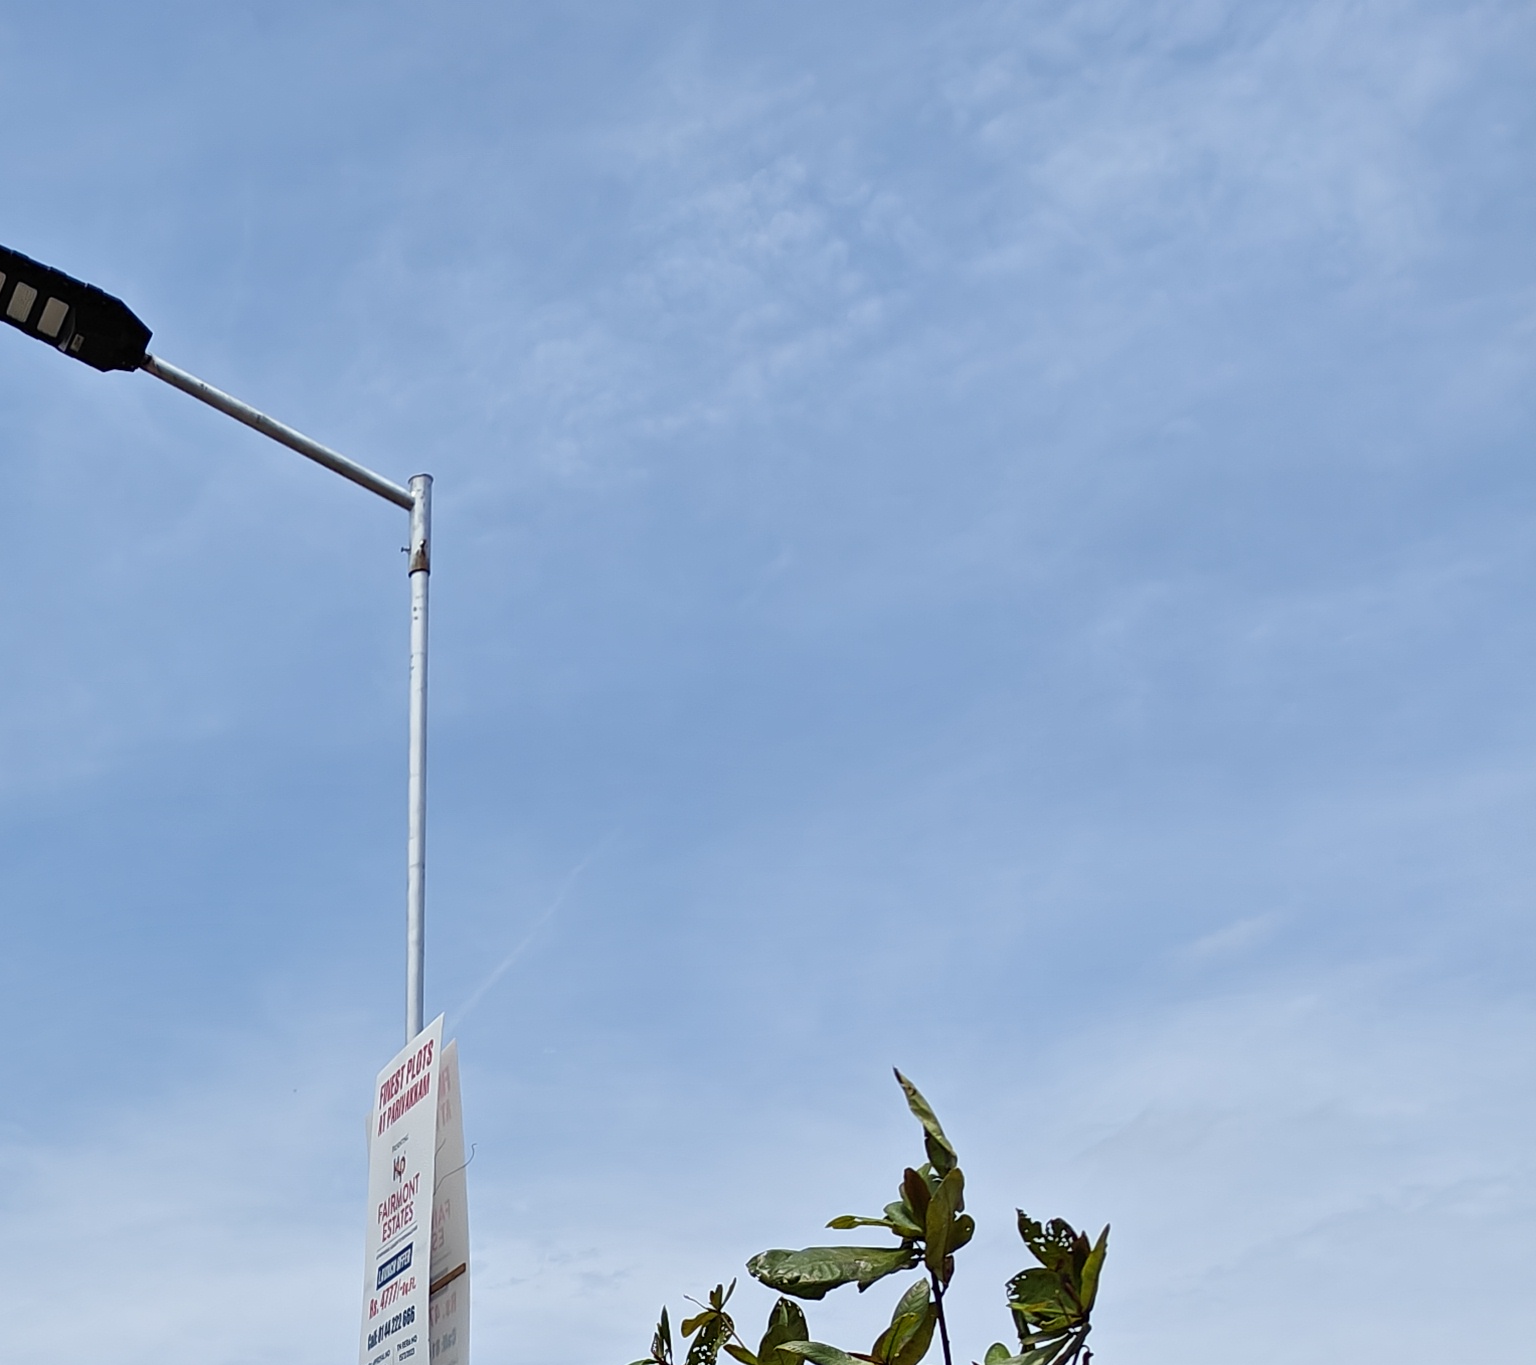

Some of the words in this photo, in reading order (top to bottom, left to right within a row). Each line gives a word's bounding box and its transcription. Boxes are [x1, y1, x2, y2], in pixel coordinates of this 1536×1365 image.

[379, 1063, 406, 1111] FINEST
[406, 1038, 434, 1085] PLOTS
[377, 1110, 387, 1138] AT
[387, 1072, 431, 1129] PARIVAKKAM
[377, 1172, 420, 1225] FAIRMONT
[382, 1200, 414, 1243] ESTATES
